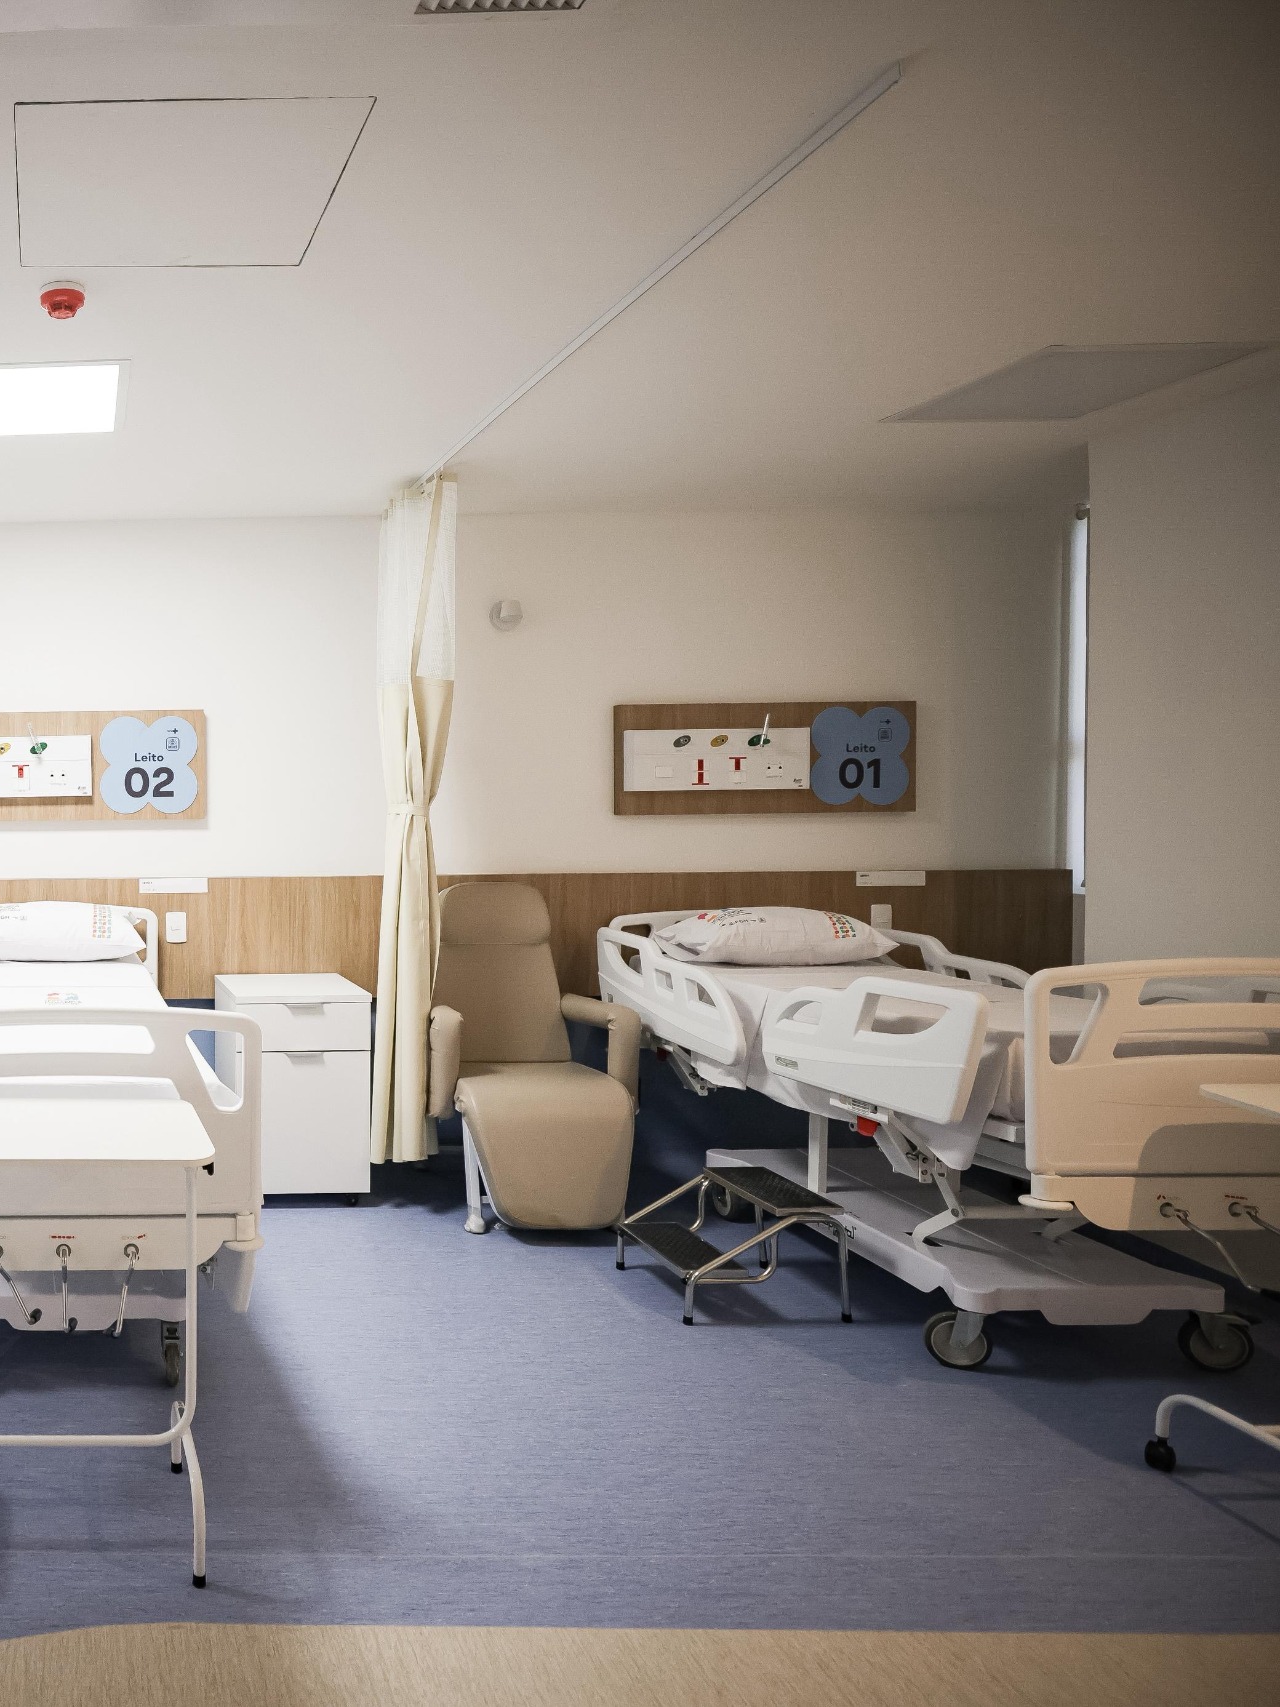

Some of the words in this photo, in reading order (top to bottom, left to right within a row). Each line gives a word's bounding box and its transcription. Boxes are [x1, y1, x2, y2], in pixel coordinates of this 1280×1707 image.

[134, 752, 165, 763] Leito
[846, 743, 876, 753] Leito
[124, 767, 174, 798] 02
[839, 758, 881, 789] 01
